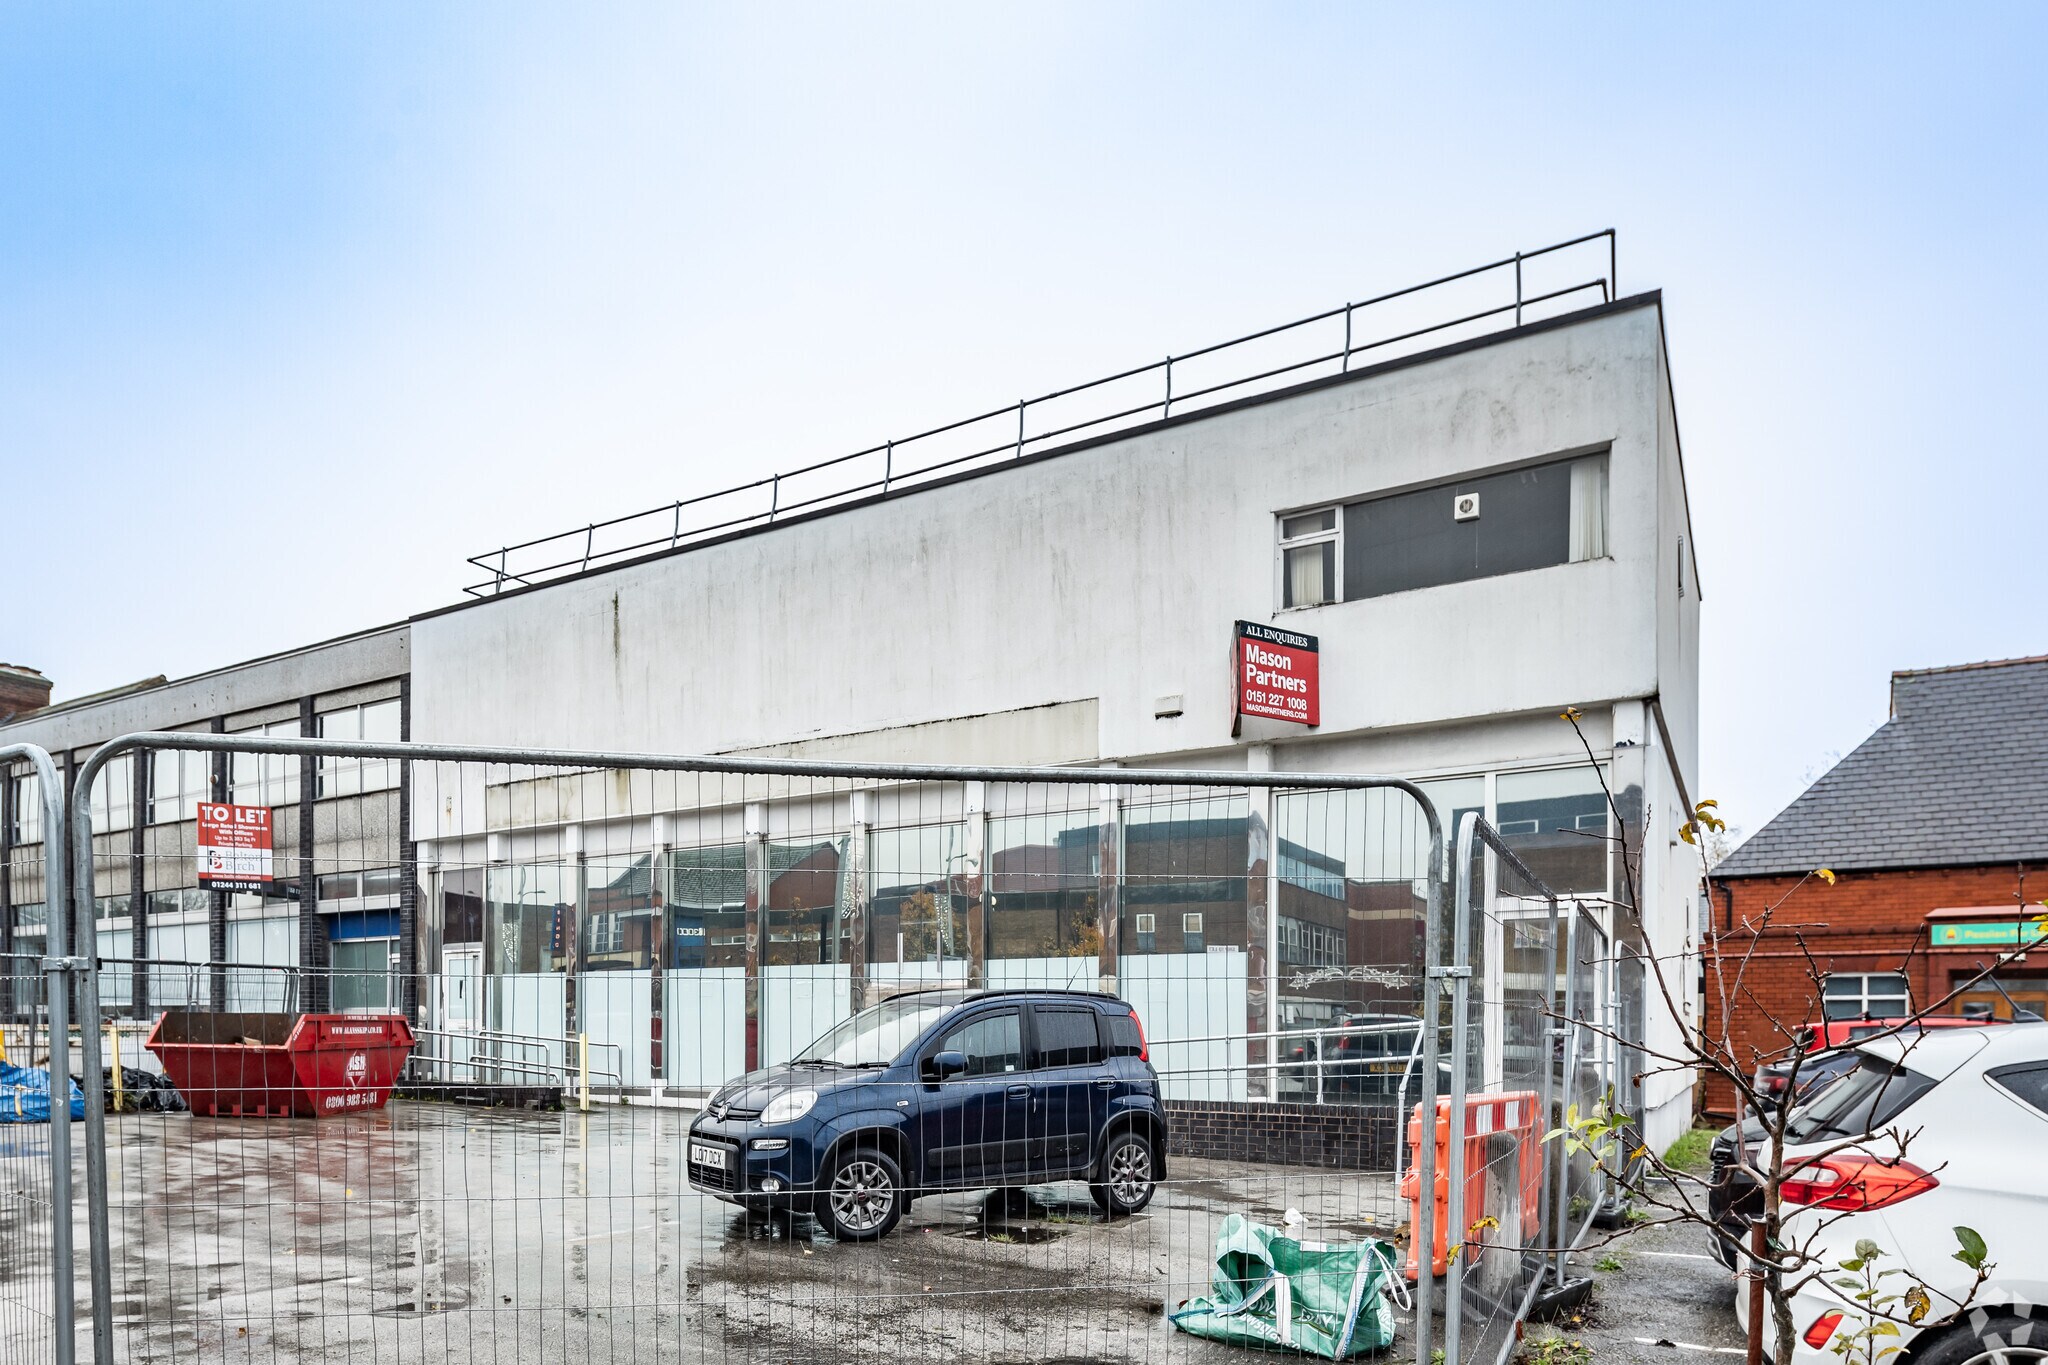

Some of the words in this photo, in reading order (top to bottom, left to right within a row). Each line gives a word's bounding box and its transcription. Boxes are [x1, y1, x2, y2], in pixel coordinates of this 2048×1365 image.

[1246, 625, 1263, 637] ALL
[1264, 628, 1308, 647] ENQUIRIES
[1246, 643, 1291, 670] Mason
[1246, 663, 1307, 693] Partners
[1246, 689, 1266, 703] 0151
[1268, 693, 1284, 706] 227
[1287, 697, 1307, 710] 1008
[1246, 703, 1307, 719] MASONPARTNERS.COM
[201, 806, 229, 822] TO
[235, 808, 267, 824] LET
[225, 851, 262, 862] Blton
[225, 861, 255, 871] Brch
